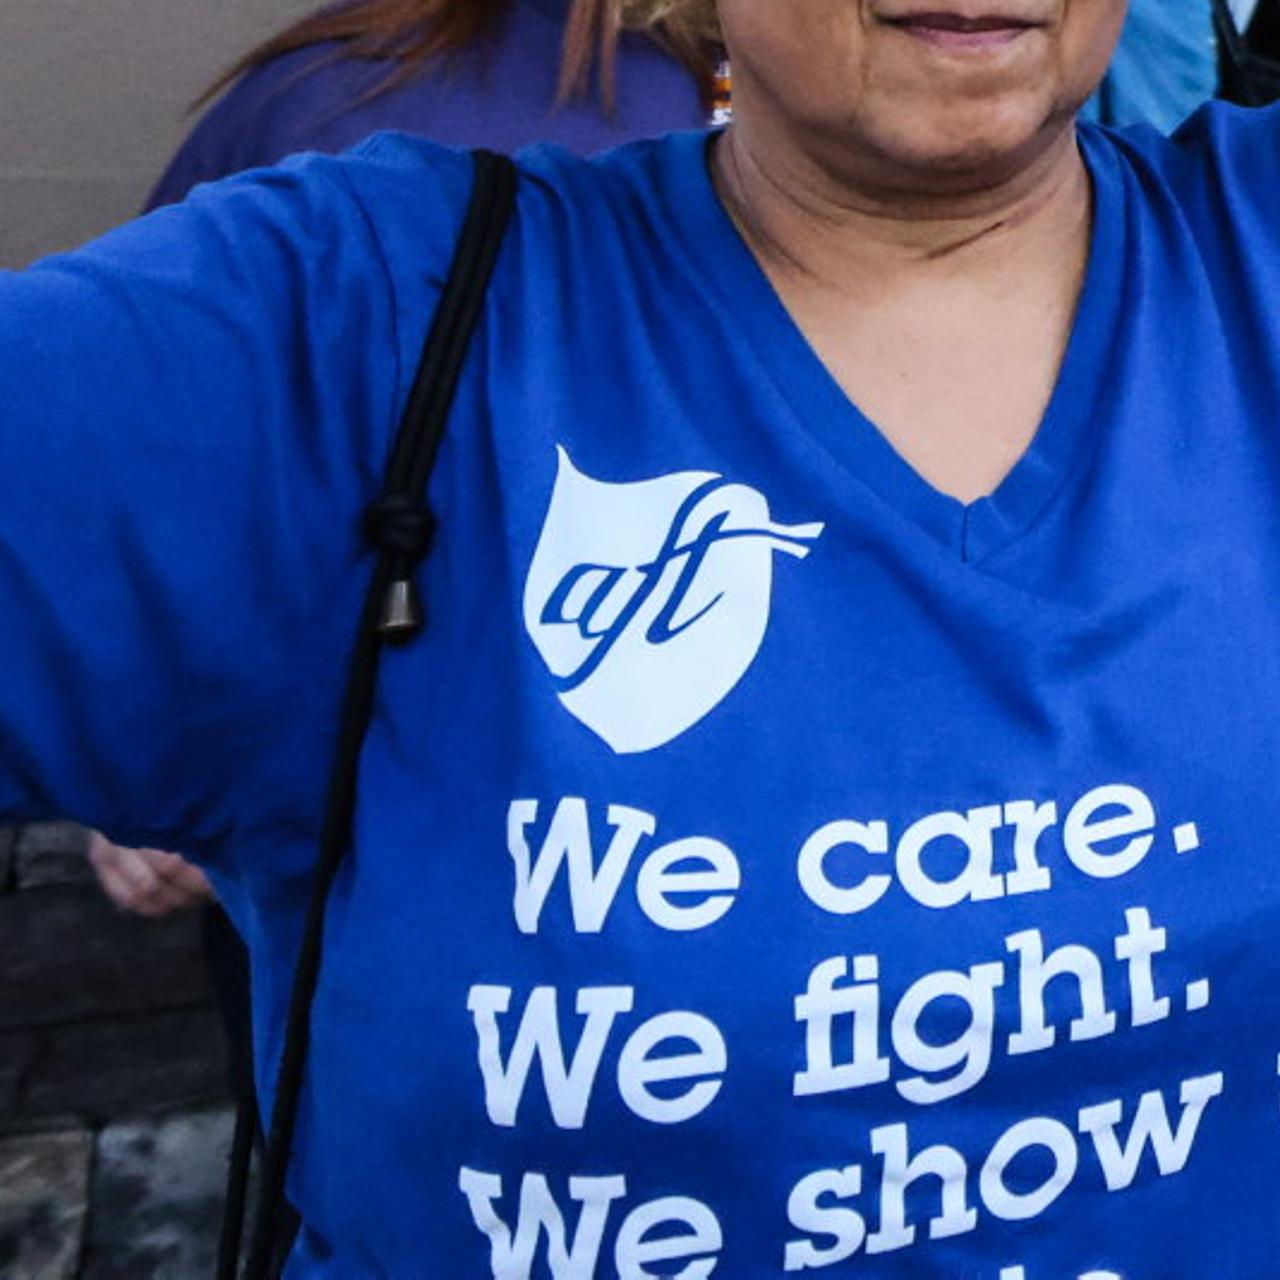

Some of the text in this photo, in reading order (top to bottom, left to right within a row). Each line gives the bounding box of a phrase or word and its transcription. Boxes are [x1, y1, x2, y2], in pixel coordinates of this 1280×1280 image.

[541, 475, 818, 694] aft
[507, 783, 1201, 934] We care.
[467, 906, 1210, 1130] We fight.
[459, 1167, 724, 1280] We
[784, 1071, 1223, 1272] show
